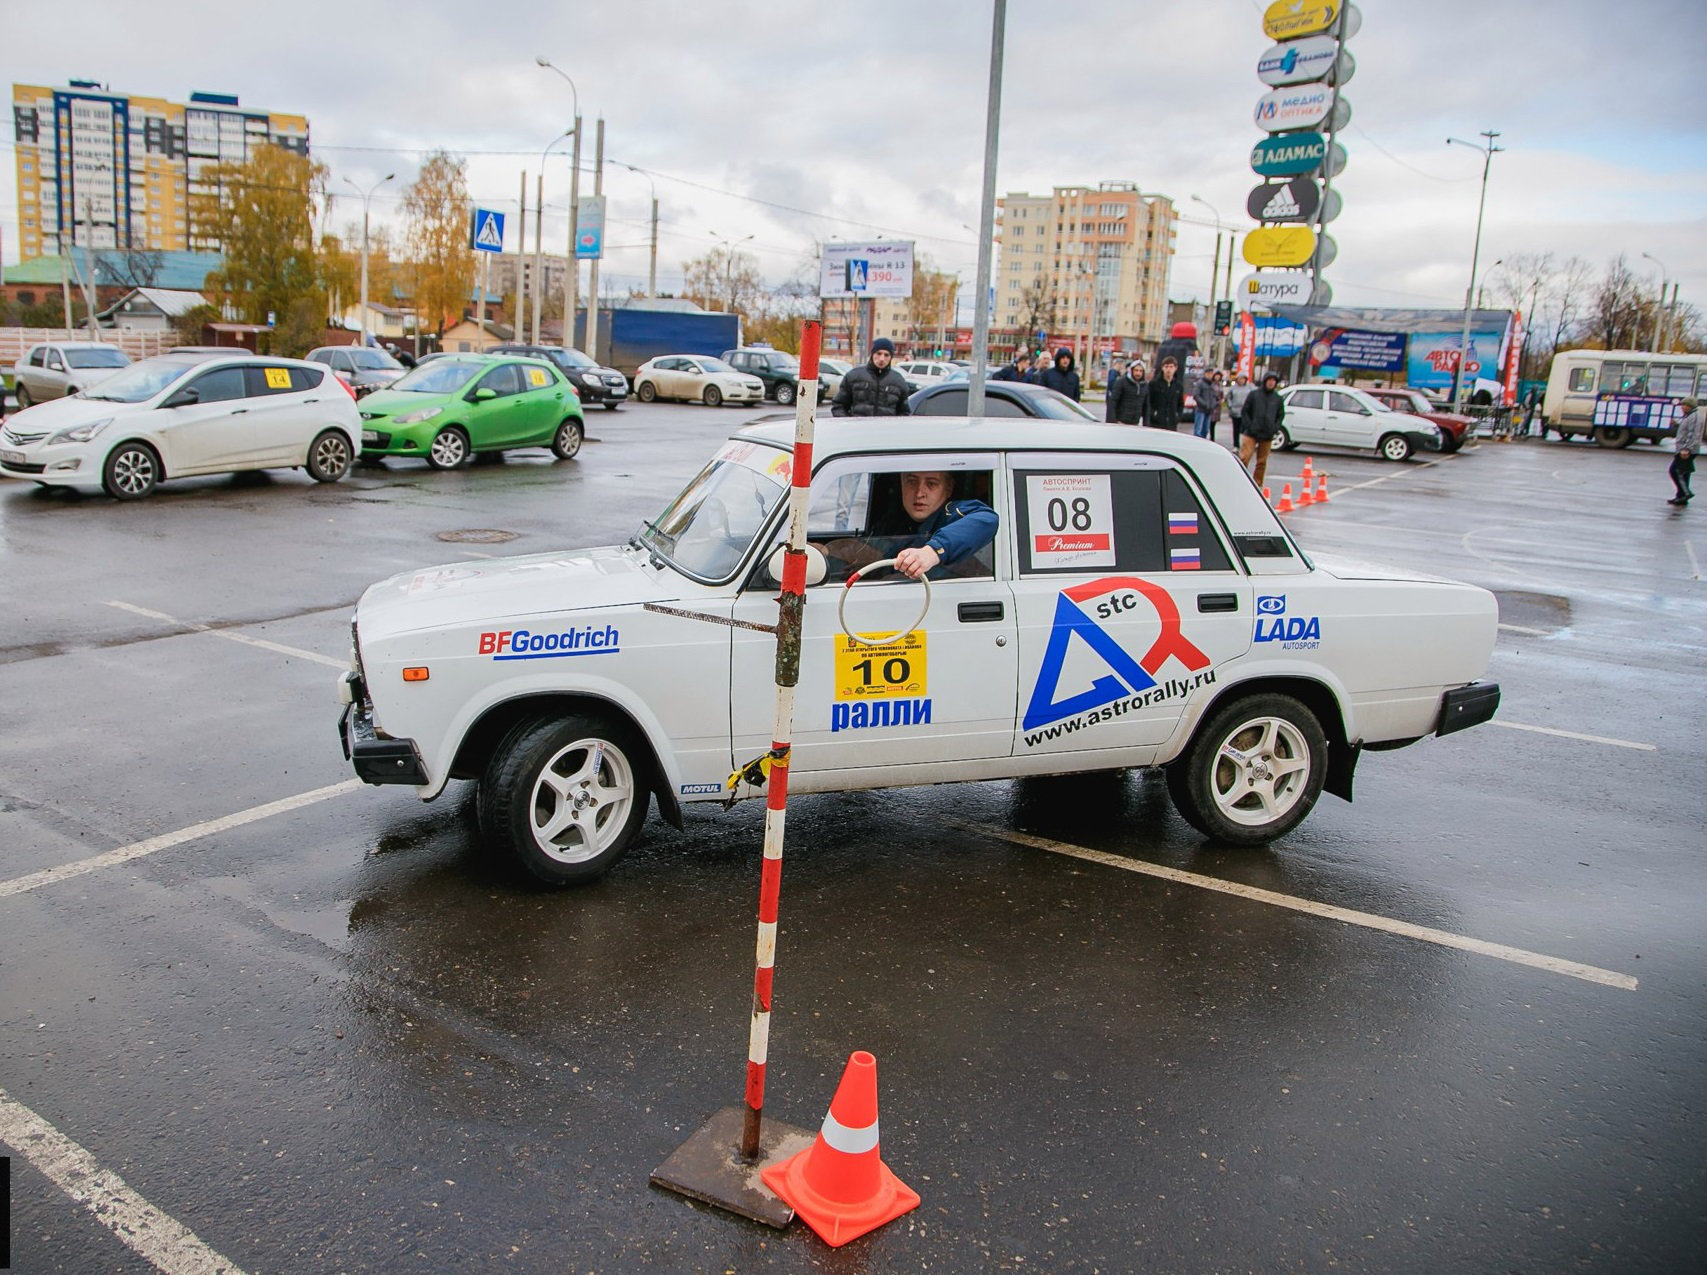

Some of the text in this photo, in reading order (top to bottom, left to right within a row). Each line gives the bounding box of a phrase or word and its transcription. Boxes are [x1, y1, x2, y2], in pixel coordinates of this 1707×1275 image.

[1265, 144, 1323, 163] АДАМАС
[1263, 204, 1299, 218] adidas
[1248, 280, 1299, 298] Шатура
[1424, 350, 1462, 362] АВТО
[1043, 478, 1092, 486] АВТОСПРИНТ
[1047, 497, 1092, 531] 08
[1048, 536, 1095, 550] Premium
[1096, 593, 1137, 619] stc
[1254, 617, 1320, 642] LADA
[478, 625, 619, 655] BFGoodrich
[1282, 642, 1320, 650] AUTOSPORT
[852, 658, 911, 685] 10
[831, 698, 932, 732] ралли
[1023, 669, 1217, 748] www.astrorally.ru
[683, 785, 719, 794] MOTUL
